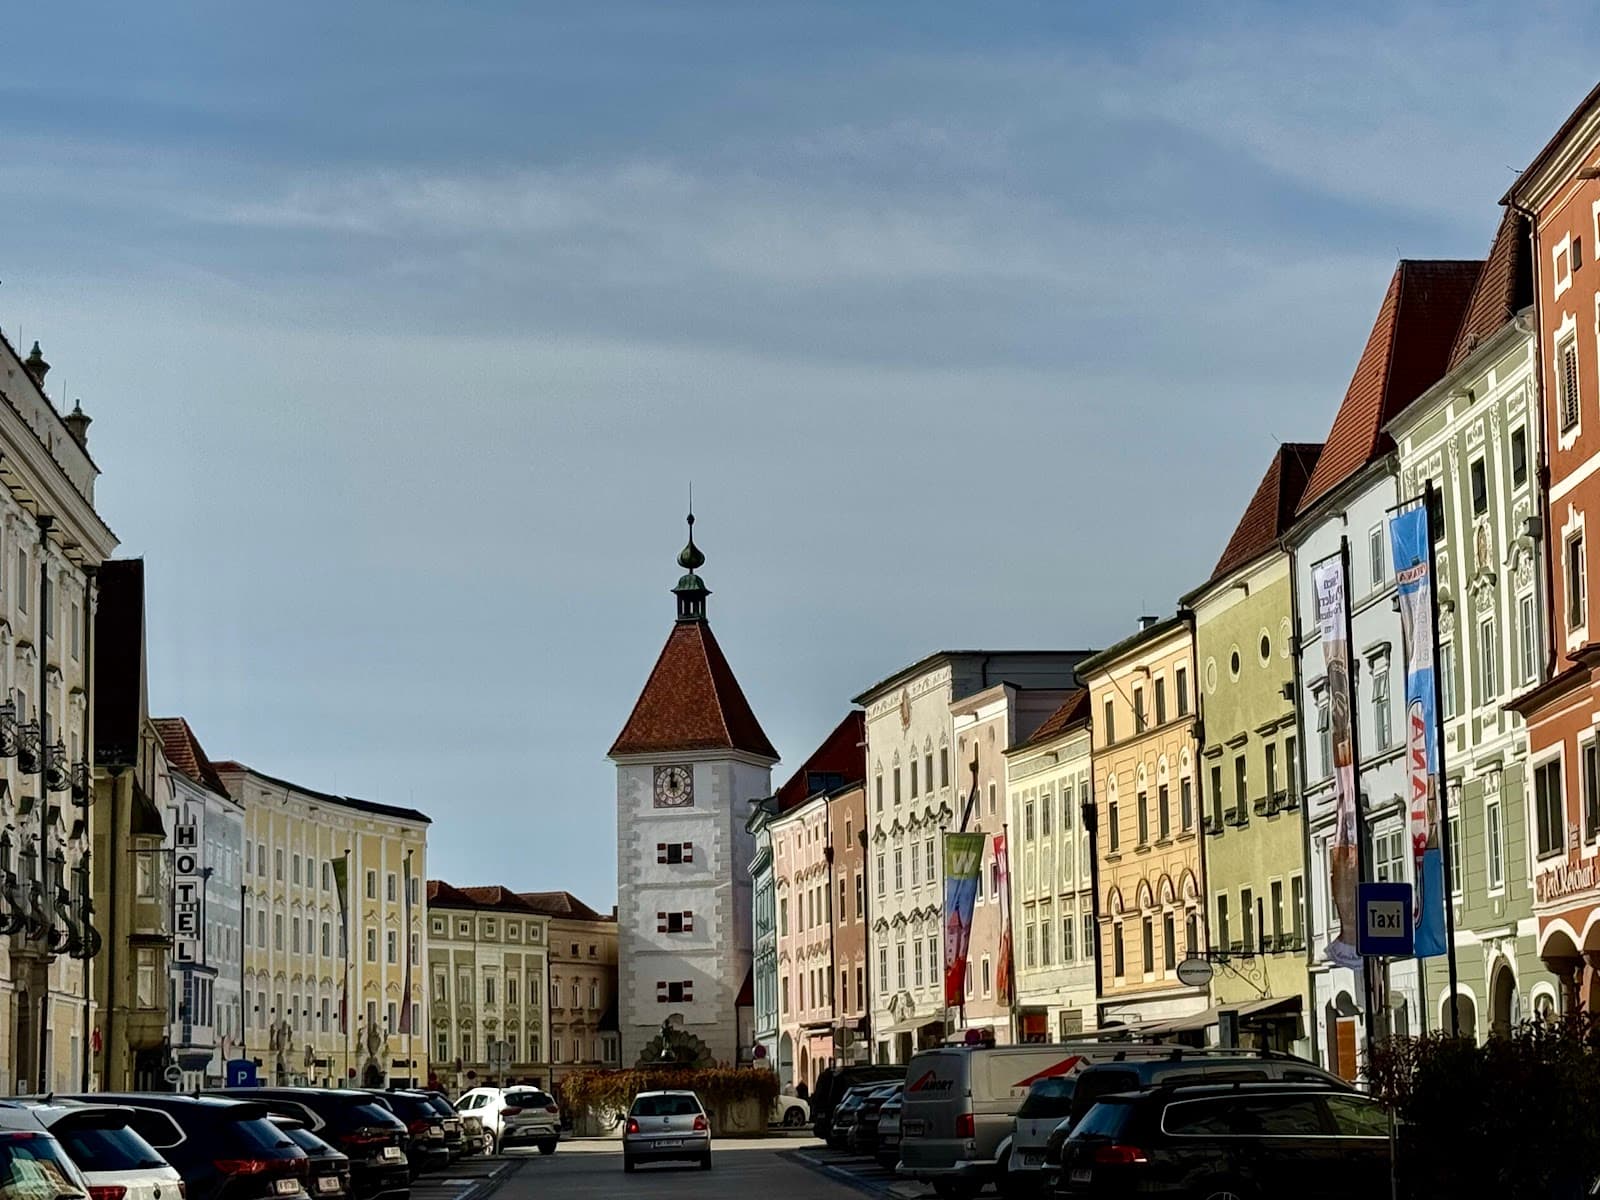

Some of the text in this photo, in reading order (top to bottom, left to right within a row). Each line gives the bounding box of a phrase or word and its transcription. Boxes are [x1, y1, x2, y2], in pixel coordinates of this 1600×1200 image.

[177, 826, 195, 960] HOTEL
[1369, 909, 1400, 929] Taxi
[237, 1071, 248, 1084] P
